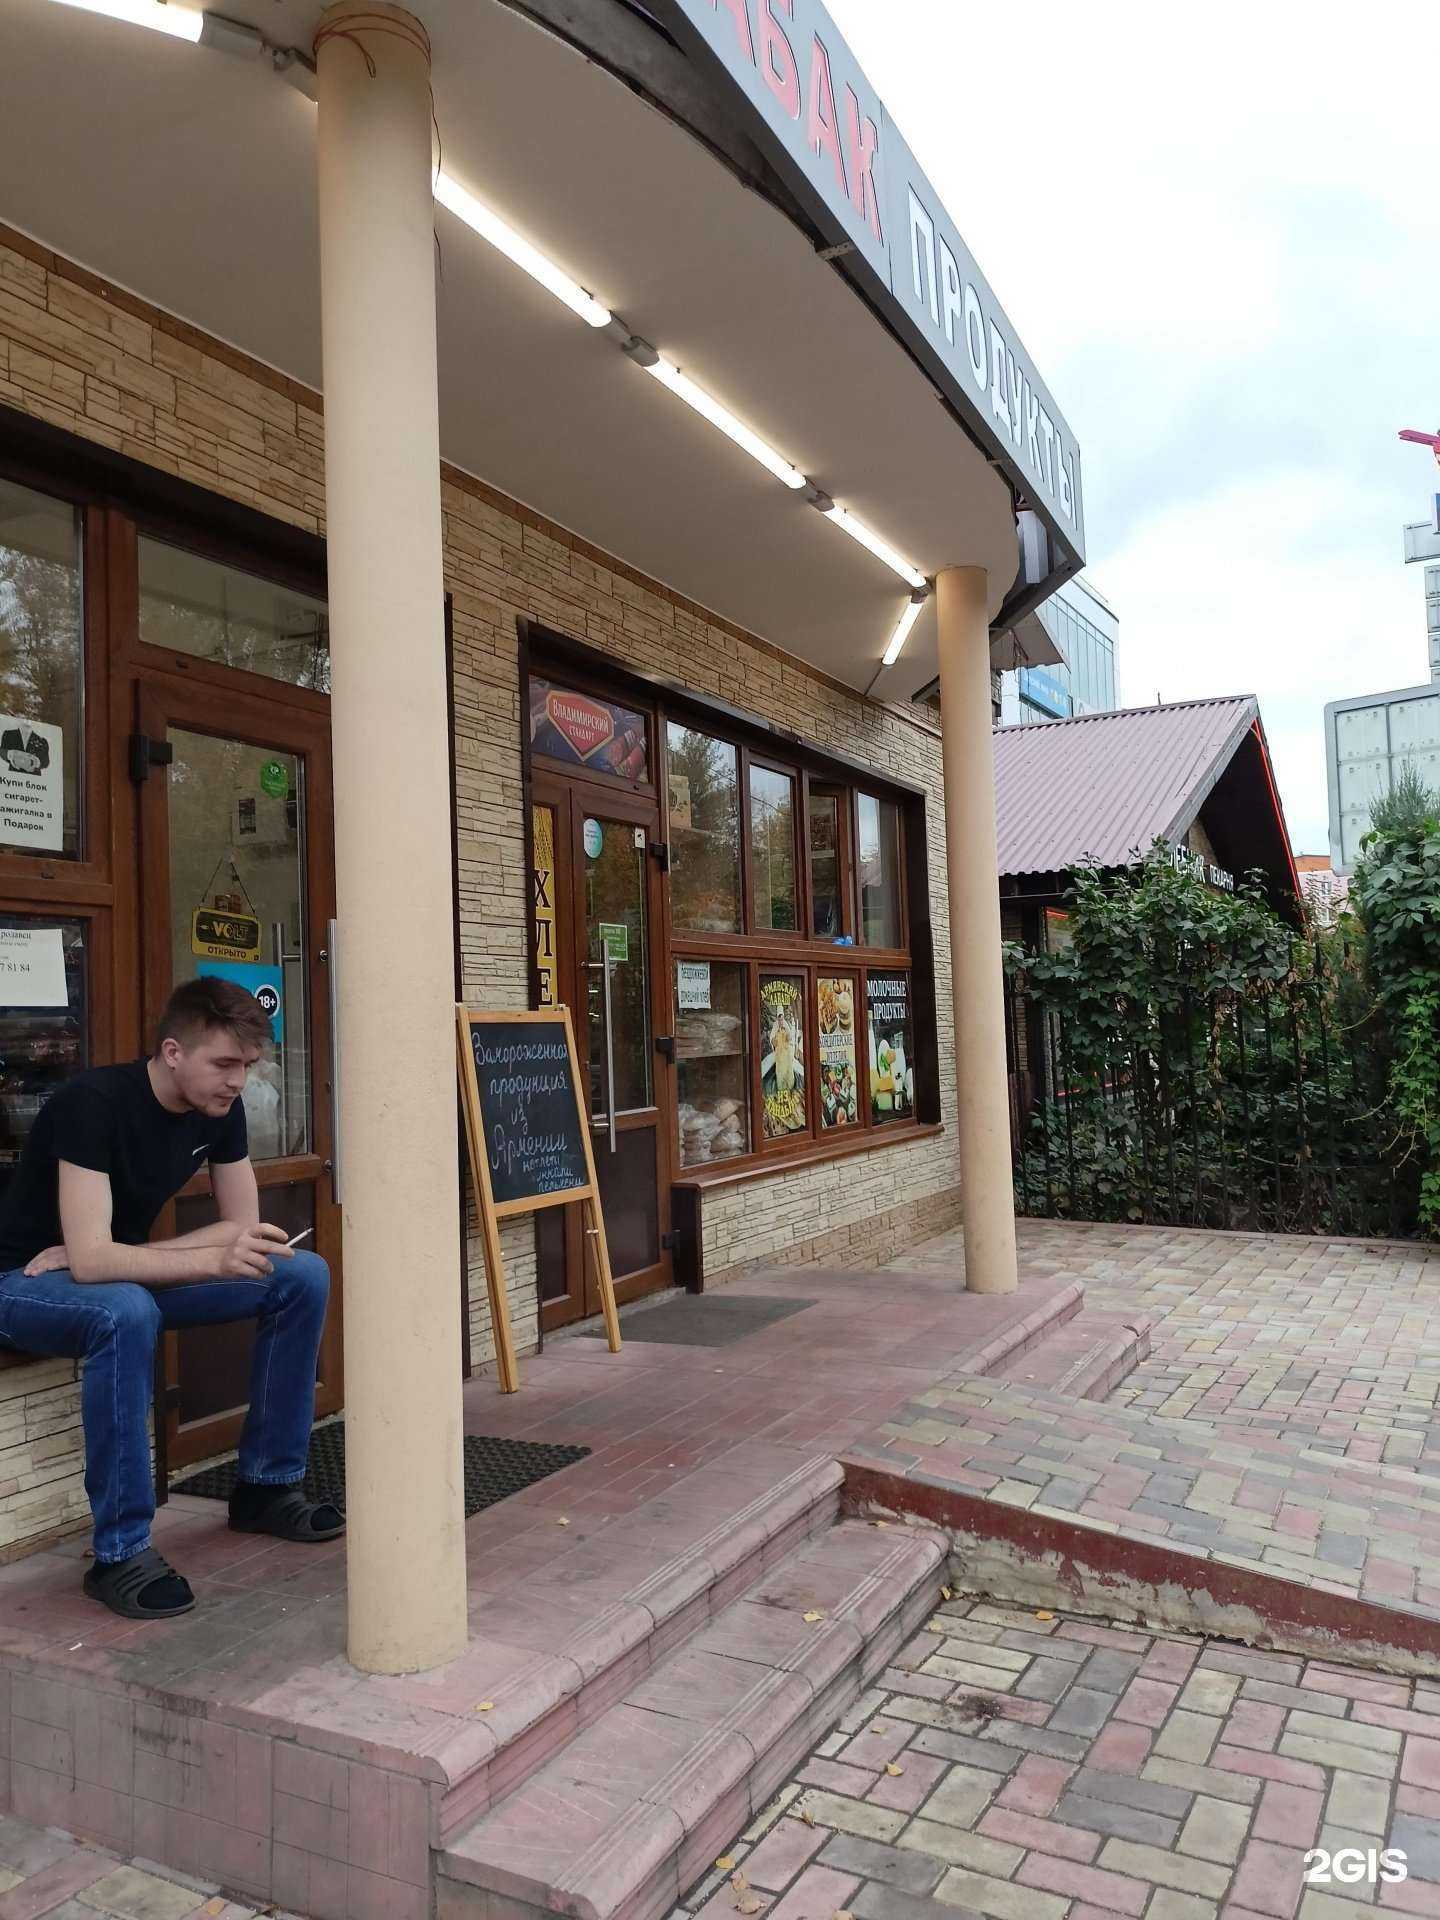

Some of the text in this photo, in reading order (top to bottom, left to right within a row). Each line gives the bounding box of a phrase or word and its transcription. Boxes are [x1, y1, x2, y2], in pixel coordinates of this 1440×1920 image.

[907, 180, 1077, 531] ПРОДУКТЫ
[0, 777, 47, 791] Купи блок
[4, 818, 44, 831] Подарок
[212, 920, 248, 940] VOLT
[207, 945, 247, 959] ОТКРЫТО
[867, 980, 907, 997] МОЛОЧНЫЕ
[259, 995, 276, 1009] 18+
[873, 1003, 906, 1022] ПРОДУКТЫ
[490, 1071, 568, 1106] продукция
[511, 1107, 528, 1135] из
[491, 1124, 568, 1175] Армении
